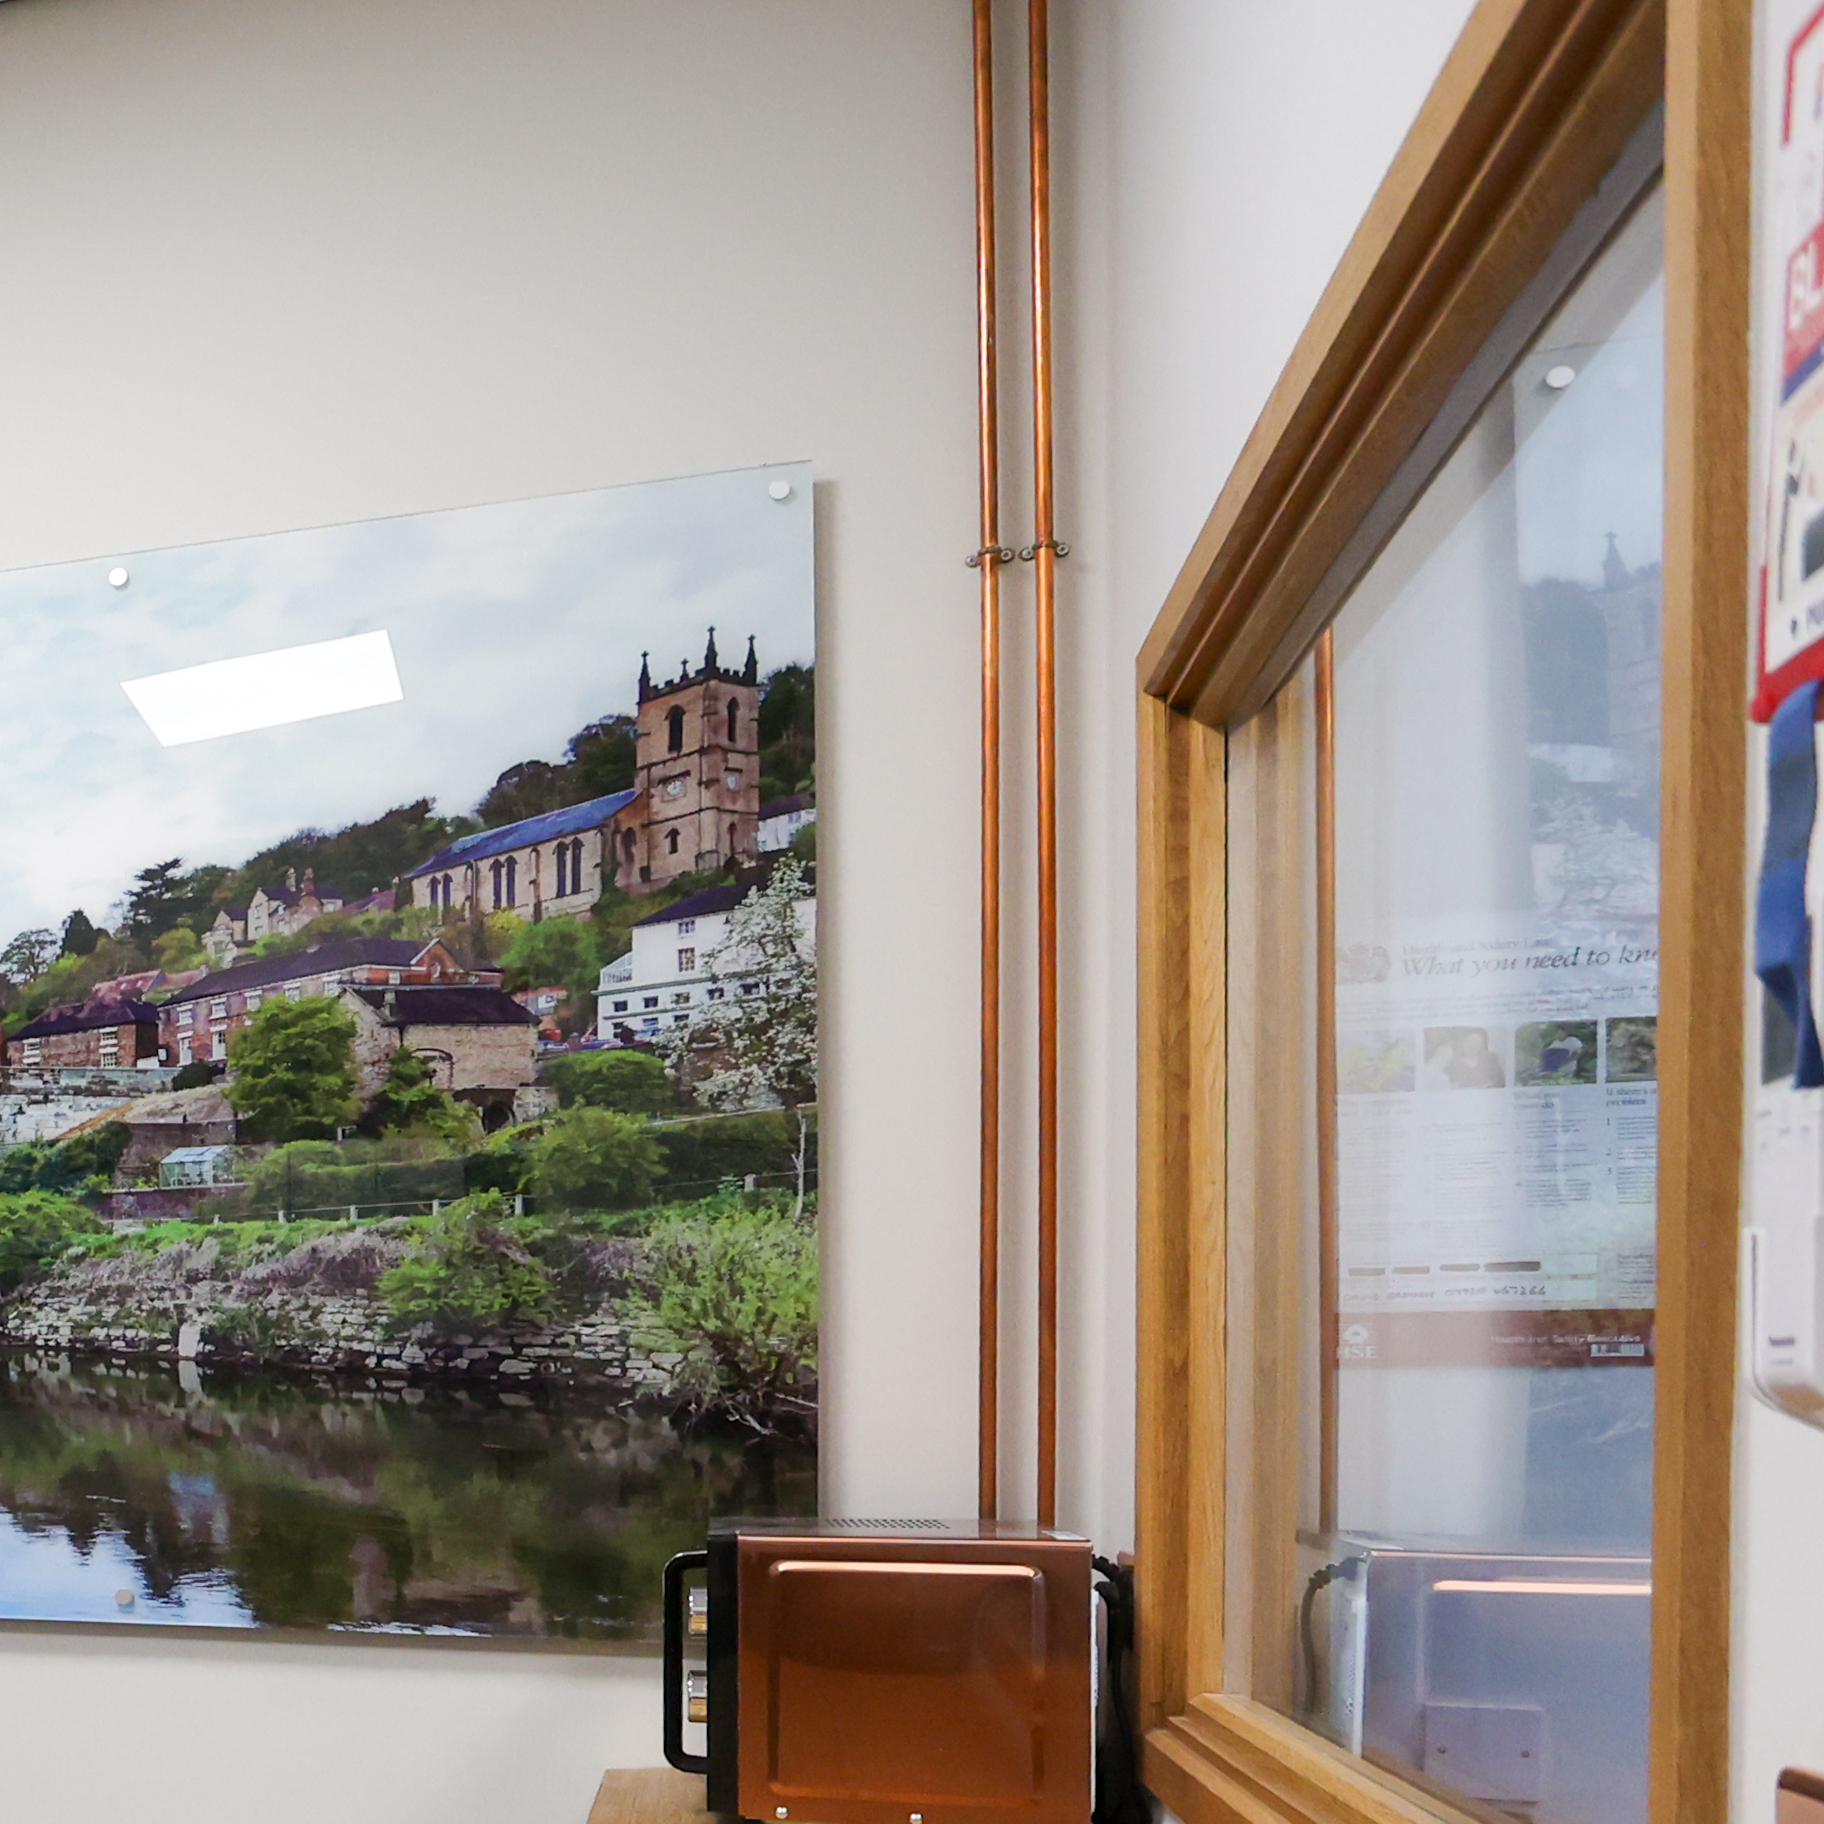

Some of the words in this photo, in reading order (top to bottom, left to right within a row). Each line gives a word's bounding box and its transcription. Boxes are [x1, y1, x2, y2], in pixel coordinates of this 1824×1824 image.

[1472, 958, 1516, 978] you
[1524, 946, 1581, 969] need
[1586, 948, 1611, 966] to
